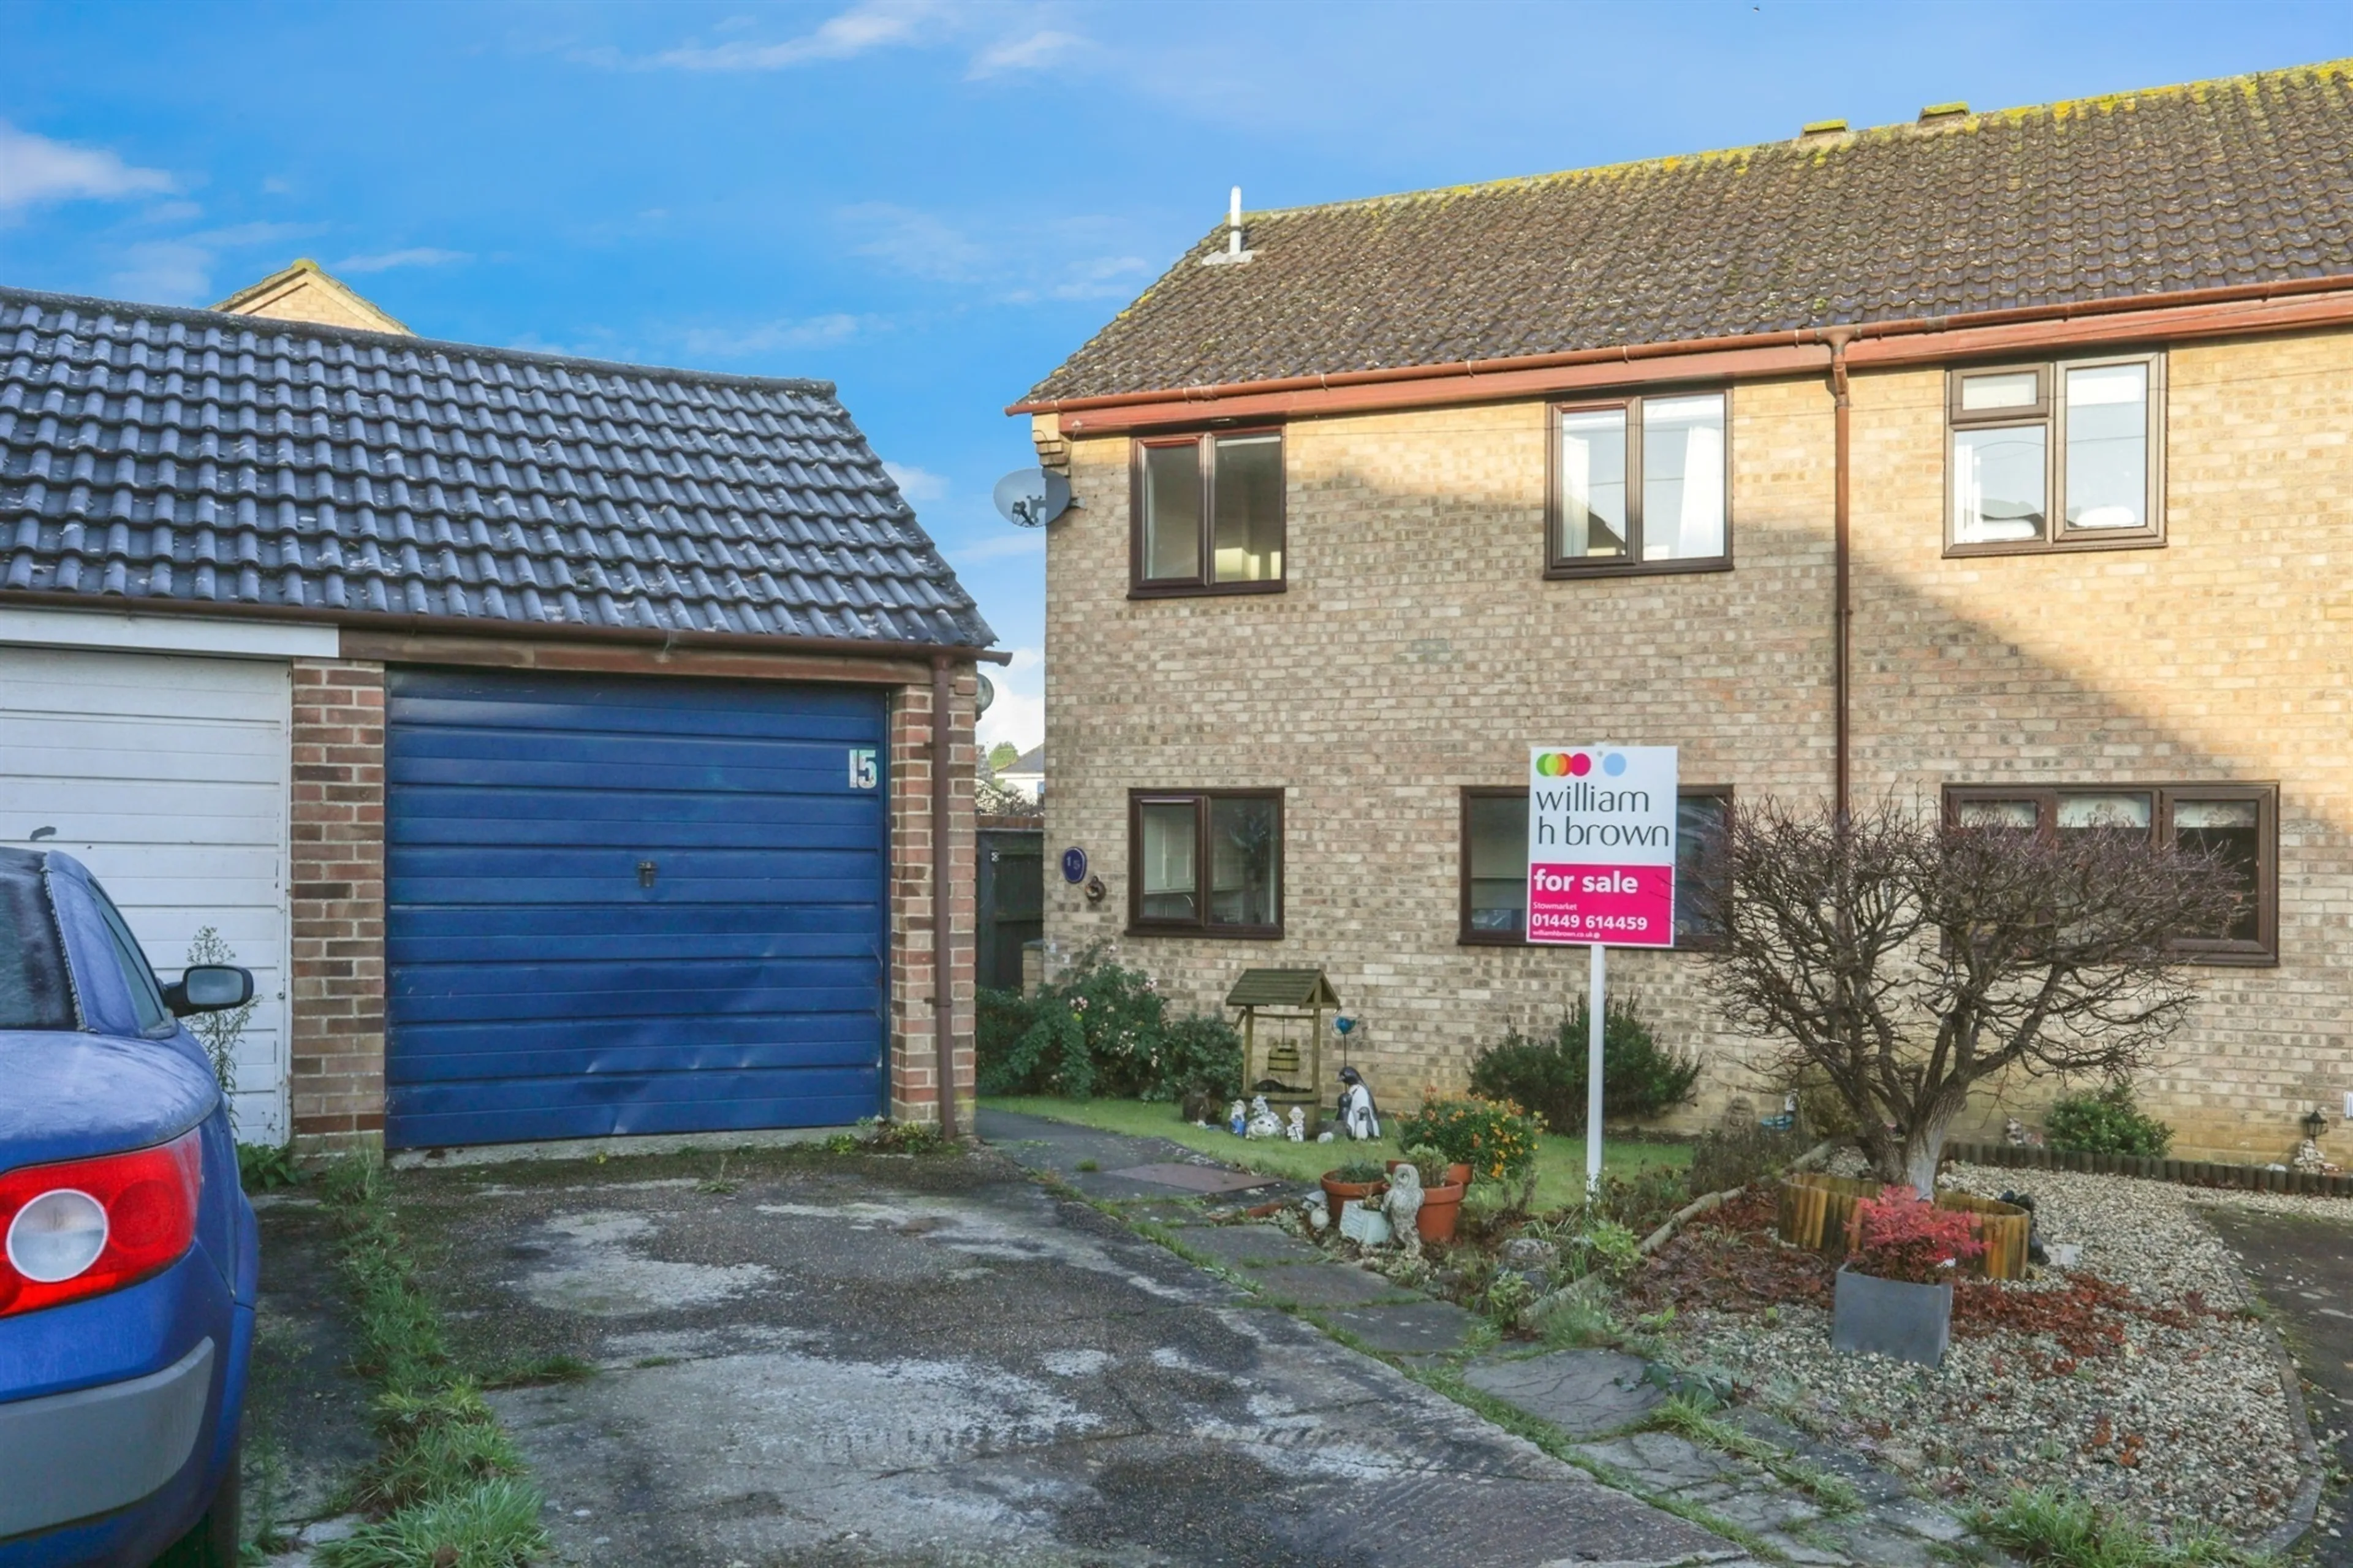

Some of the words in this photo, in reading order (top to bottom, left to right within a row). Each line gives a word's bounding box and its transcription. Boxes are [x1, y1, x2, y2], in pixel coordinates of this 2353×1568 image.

[849, 749, 877, 789] 15
[1536, 782, 1649, 812] william
[1539, 816, 1555, 844] h
[1566, 816, 1669, 846] brown
[1066, 856, 1081, 870] 15
[1534, 868, 1574, 892] for
[1582, 870, 1638, 893] sale
[1533, 902, 1577, 911] Stowmarket
[1533, 914, 1580, 928] 01449
[1585, 915, 1648, 931] 614459
